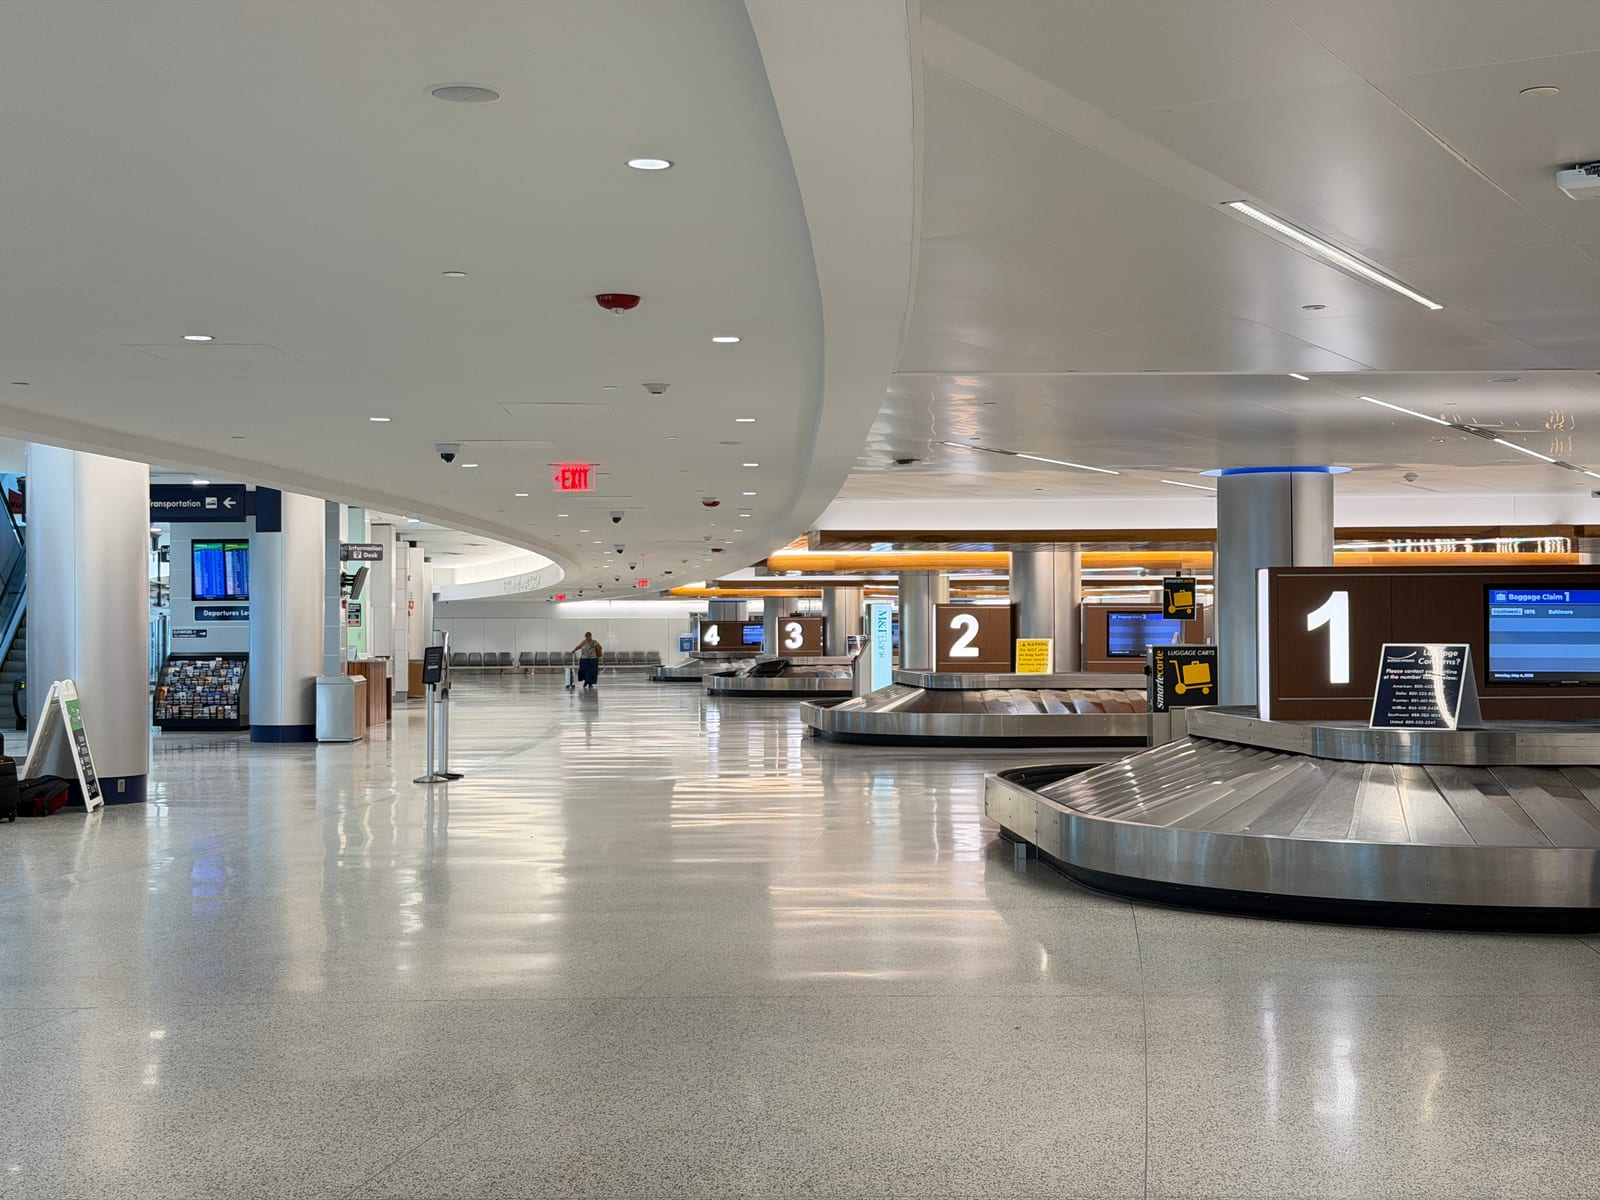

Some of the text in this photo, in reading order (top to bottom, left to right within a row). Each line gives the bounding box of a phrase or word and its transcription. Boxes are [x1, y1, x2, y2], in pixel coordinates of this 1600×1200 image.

[561, 468, 590, 489] EXIT
[150, 499, 201, 509] ransportation
[1564, 592, 1570, 602] 1
[203, 610, 239, 618] Departures
[704, 625, 720, 645] 4
[785, 622, 803, 649] 3
[877, 610, 887, 659] M&T Bank
[950, 613, 980, 657] 2
[1307, 591, 1349, 683] 1
[1423, 649, 1458, 658] Luage
[1155, 651, 1164, 710] smartecarte
